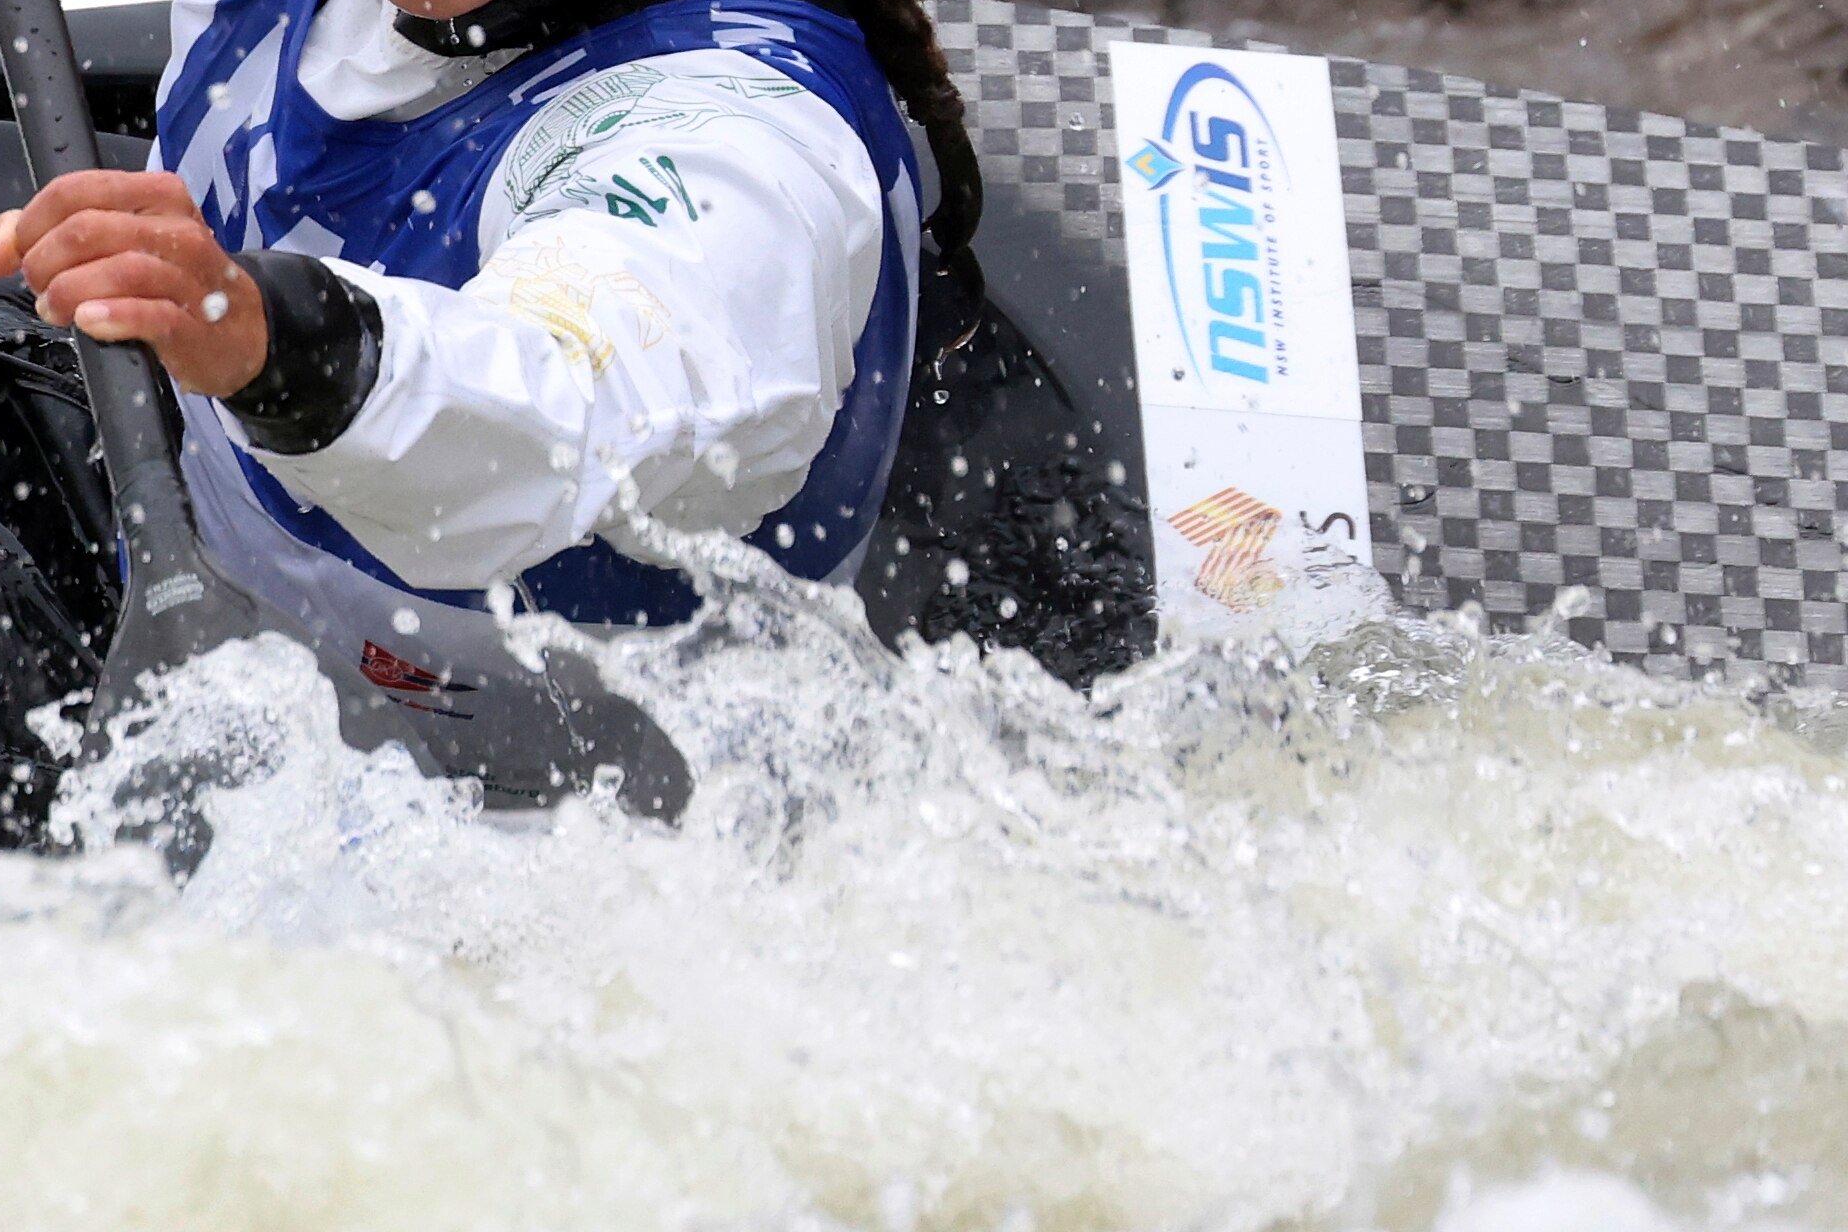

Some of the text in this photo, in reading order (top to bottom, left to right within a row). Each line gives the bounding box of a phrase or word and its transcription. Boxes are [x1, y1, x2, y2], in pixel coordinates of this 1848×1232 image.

[1256, 138, 1289, 376] NSW INSTITUTE OF SPORT
